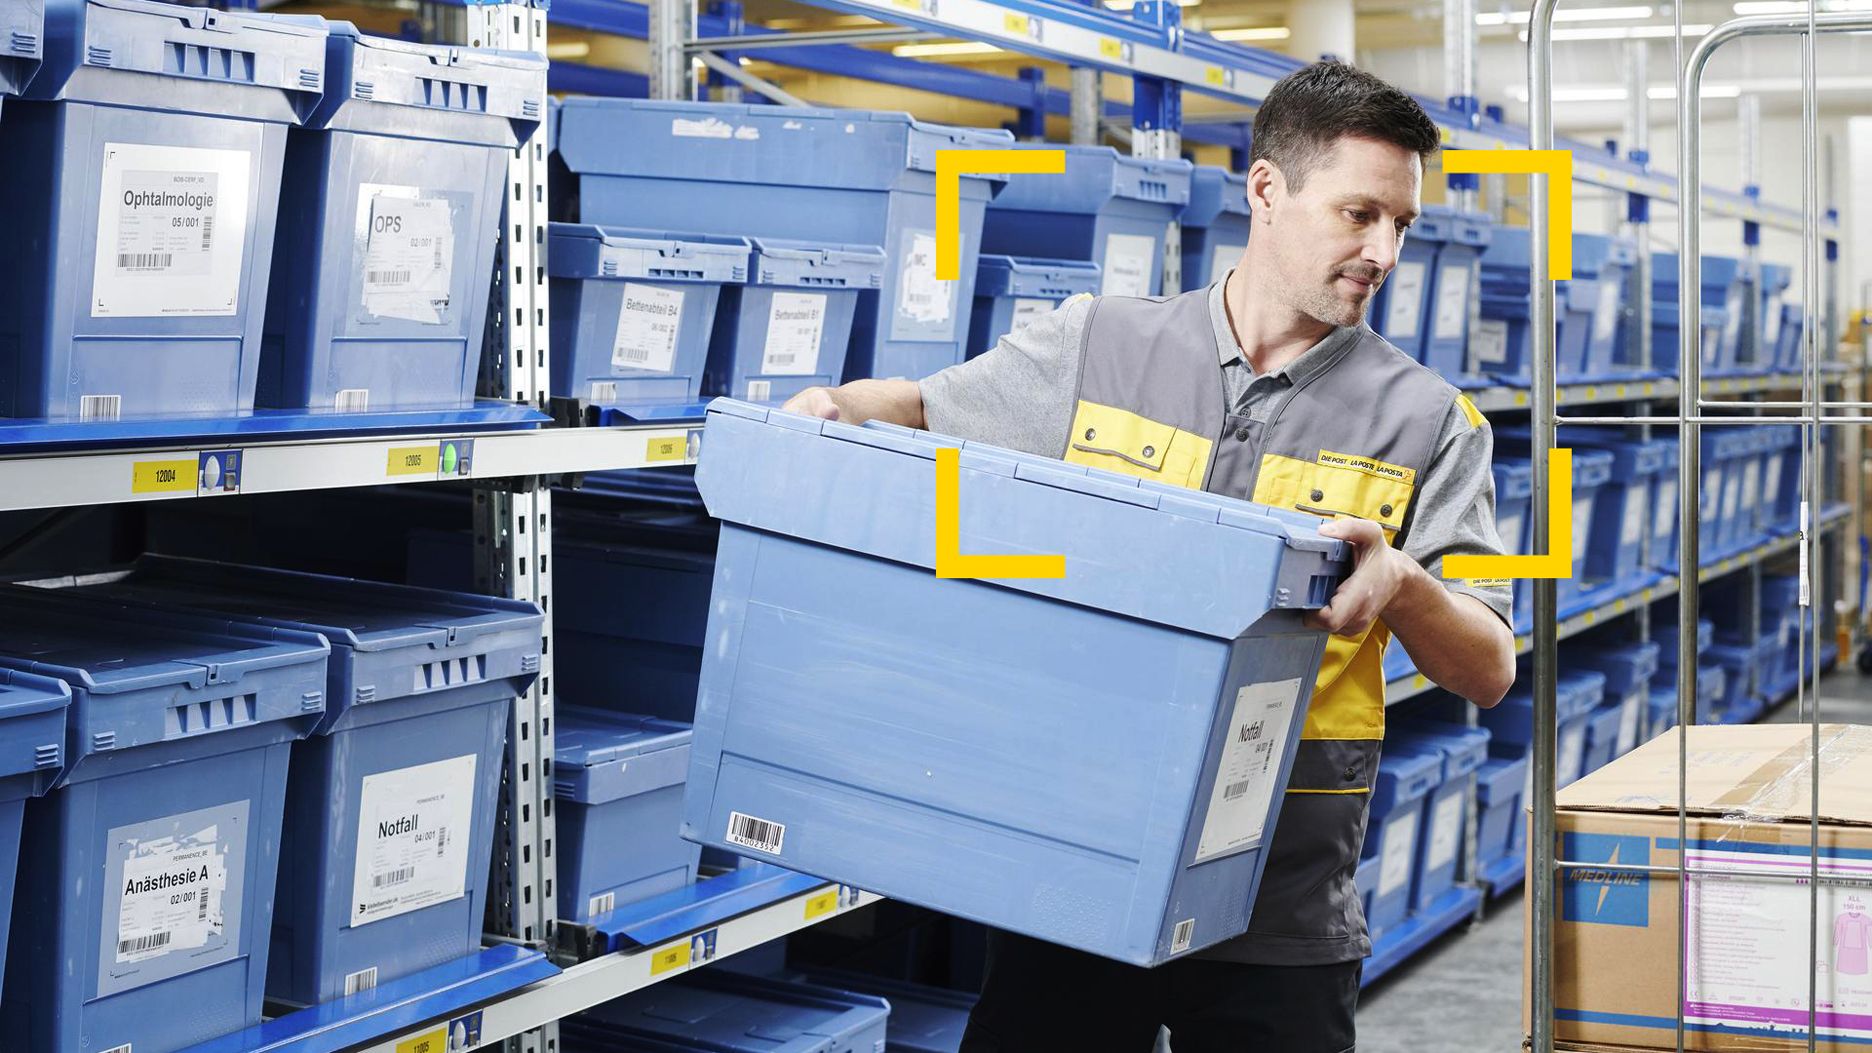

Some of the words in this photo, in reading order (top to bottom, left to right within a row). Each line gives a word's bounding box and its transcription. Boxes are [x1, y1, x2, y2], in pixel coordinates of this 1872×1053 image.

[124, 190, 213, 211] Ophtalmologie
[172, 217, 199, 228] 05/001
[375, 215, 402, 233] OPS
[626, 298, 668, 315] Bettenabteil
[668, 306, 678, 317] B4
[775, 309, 810, 320] Bettenabteil
[1321, 454, 1332, 462] DIE
[1332, 456, 1347, 465] POST
[1358, 460, 1375, 471] POSTE
[1383, 467, 1403, 478] POSTA
[156, 469, 176, 483] 12004
[1238, 720, 1264, 744] Notfall
[378, 814, 418, 839] Notfall
[415, 830, 436, 843] 04/001
[125, 868, 196, 896] Anästhesie
[199, 865, 209, 881] A
[1570, 868, 1643, 886] MEDLINE
[170, 891, 196, 905] 02/001
